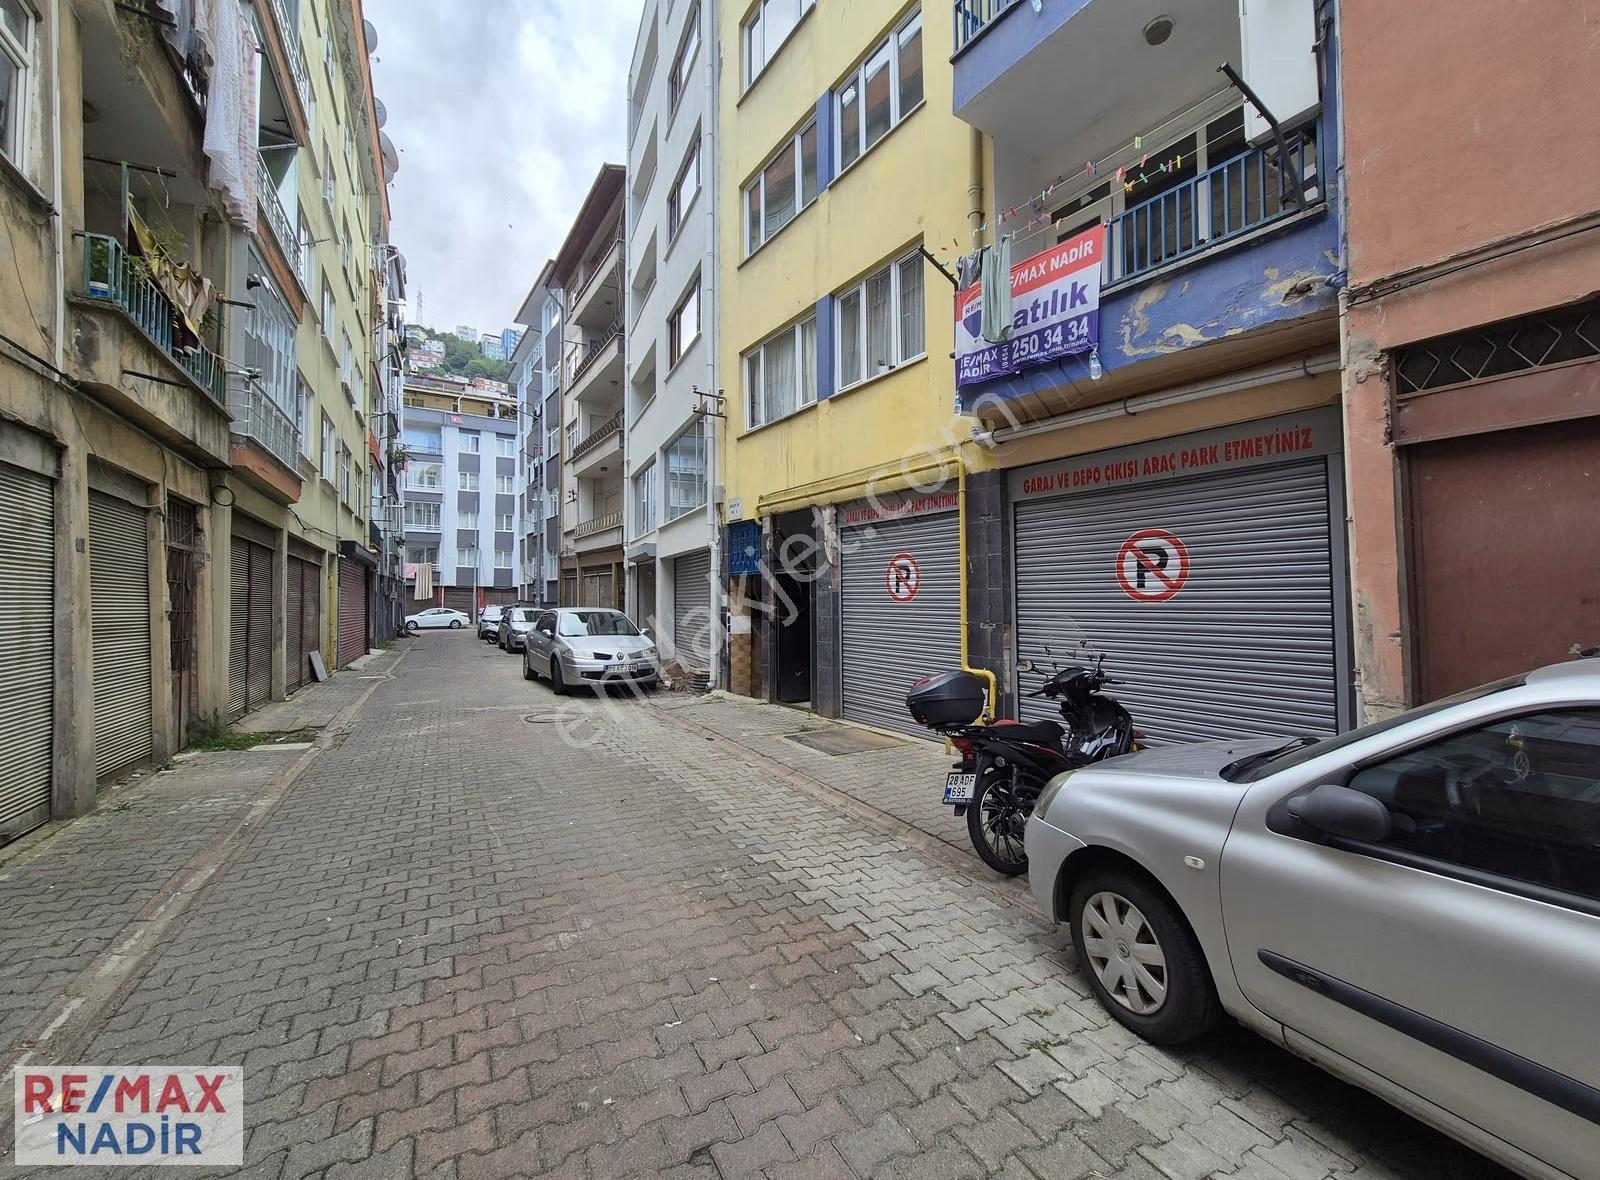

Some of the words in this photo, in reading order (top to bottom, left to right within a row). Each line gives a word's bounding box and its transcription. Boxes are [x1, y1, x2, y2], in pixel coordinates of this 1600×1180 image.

[1010, 261, 1046, 288] /MAX
[1050, 240, 1093, 272] NADİR
[965, 301, 982, 315] RE/M
[1013, 281, 1088, 329] atılık
[1012, 334, 1039, 359] 250
[1044, 325, 1062, 349] 34
[1068, 316, 1089, 341] 34
[1024, 475, 1054, 494] GARAJ
[1056, 472, 1070, 489] VE
[1073, 466, 1101, 487] DEPO
[1105, 459, 1138, 486] ÇIKIŞI
[1143, 452, 1176, 476] ARAÇ
[1181, 445, 1218, 468] PARK
[1224, 423, 1313, 462] ETMEYİNİZ
[949, 775, 959, 786] 28
[951, 787, 966, 797] 695
